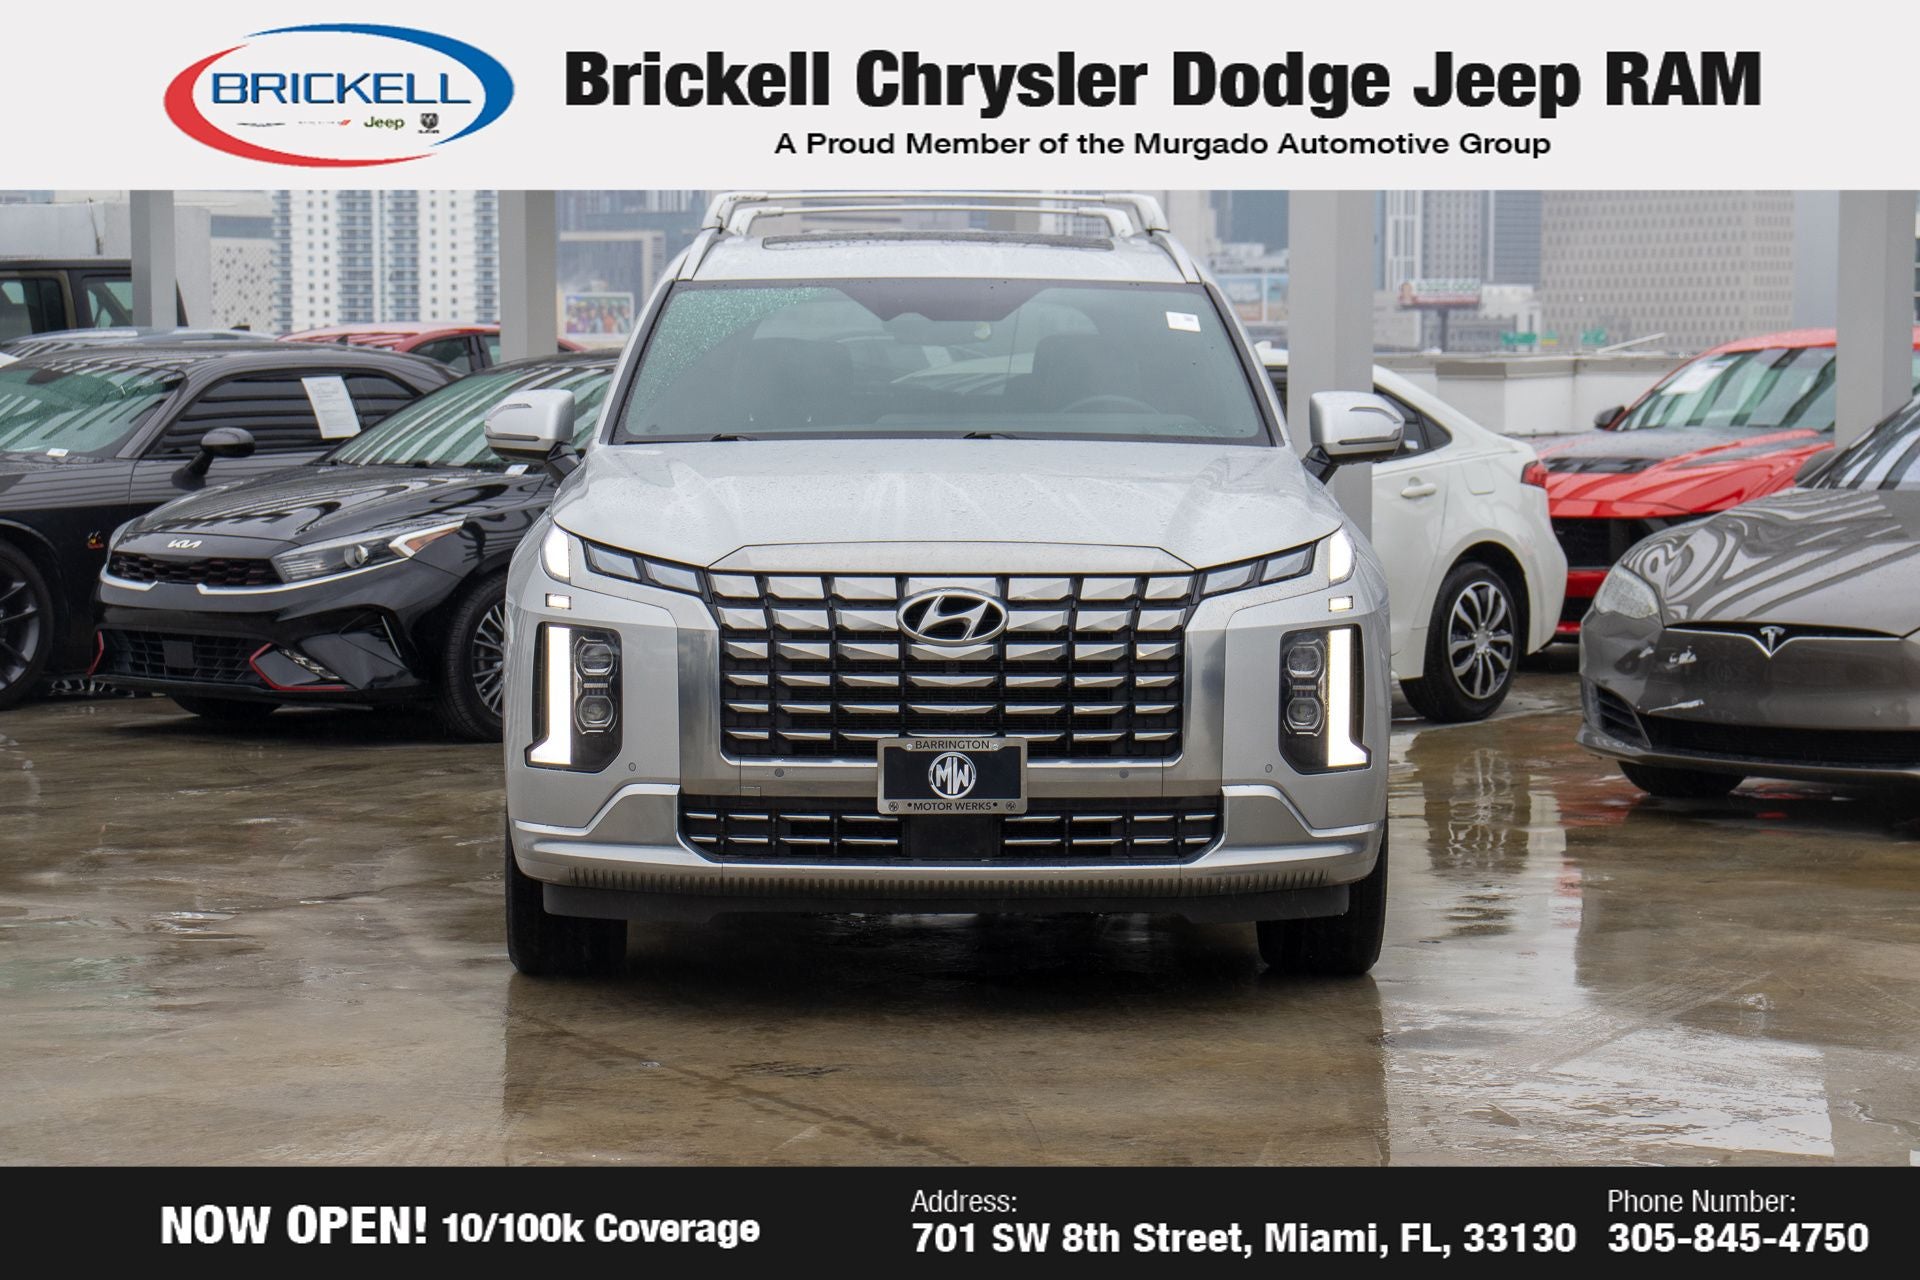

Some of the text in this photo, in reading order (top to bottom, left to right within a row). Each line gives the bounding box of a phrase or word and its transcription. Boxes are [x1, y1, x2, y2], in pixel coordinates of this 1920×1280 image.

[915, 740, 990, 749] BARRINGTON
[913, 802, 992, 811] MOTOR WERKS
